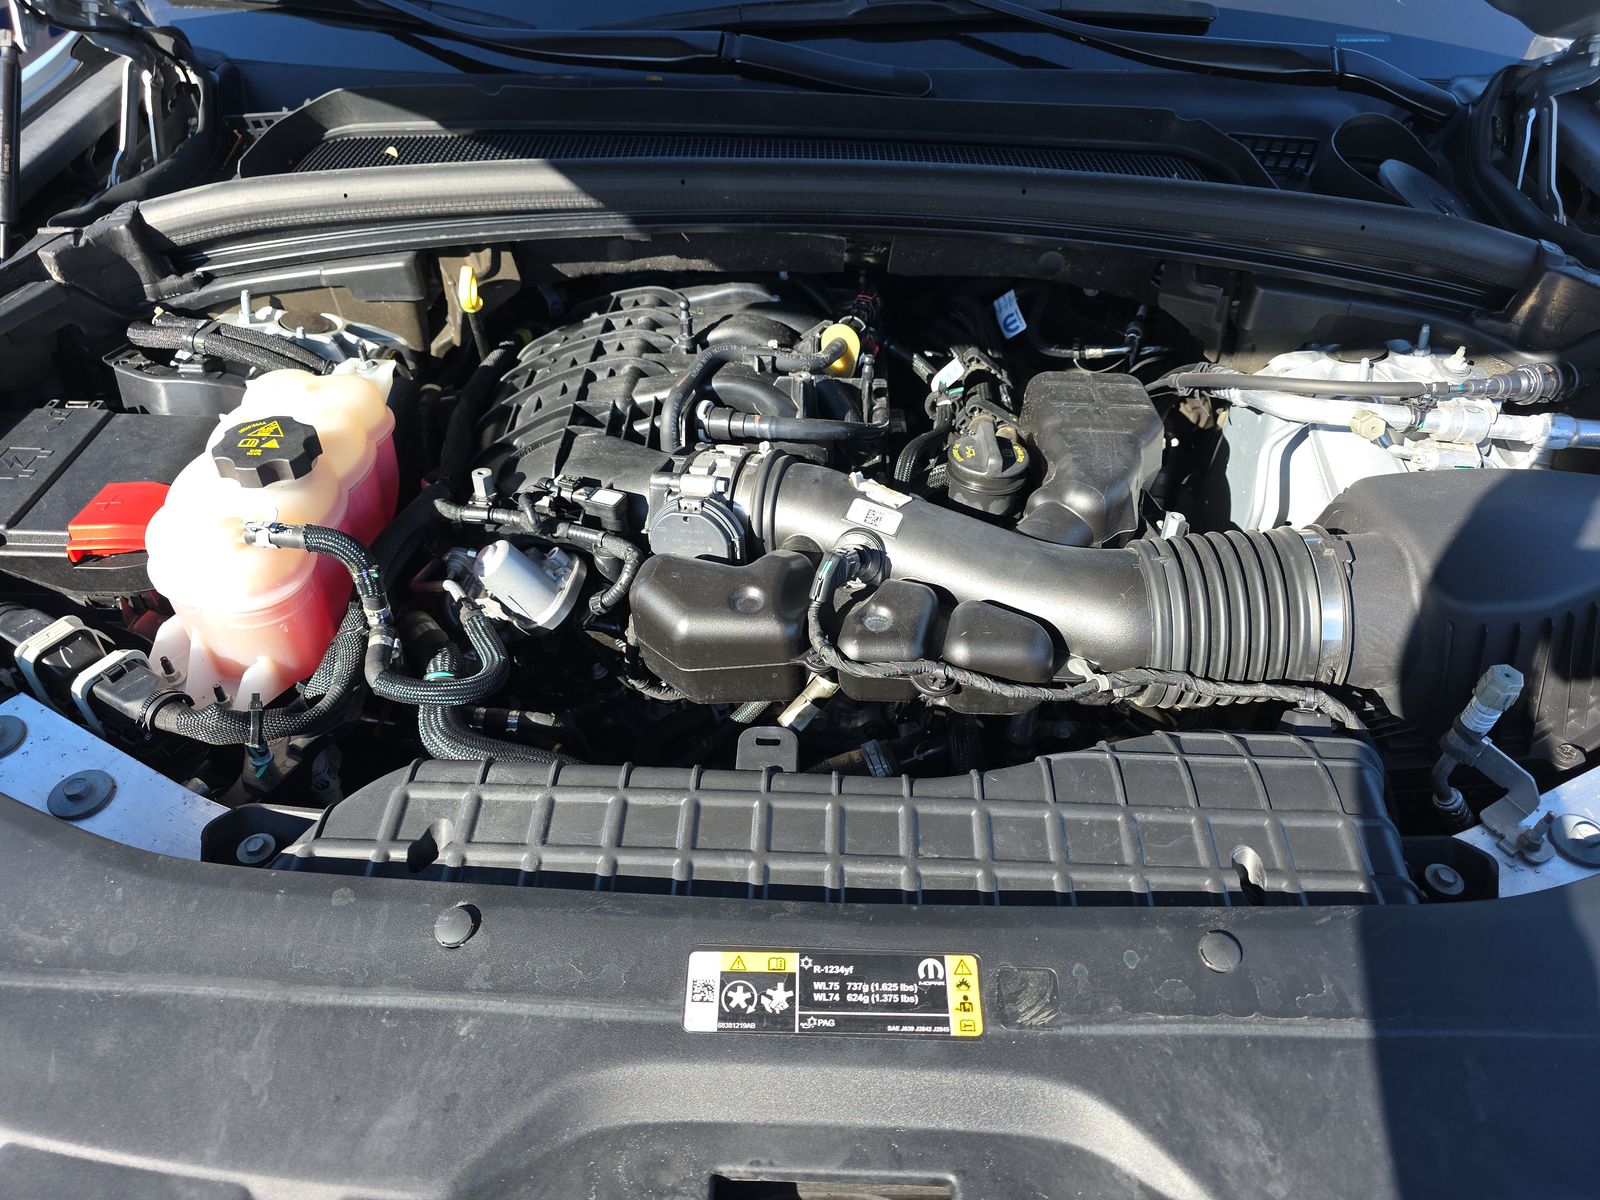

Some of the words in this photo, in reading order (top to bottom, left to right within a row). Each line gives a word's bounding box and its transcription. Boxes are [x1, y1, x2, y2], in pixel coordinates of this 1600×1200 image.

[813, 965, 854, 975] R-1234yf
[813, 981, 840, 990] WL75
[846, 982, 869, 992] 737g
[870, 982, 899, 993] (1.625
[900, 983, 919, 993] lbs)
[813, 993, 840, 1002] WL74
[846, 993, 869, 1004] 624g
[870, 994, 899, 1004] (1.375
[900, 994, 919, 1005] lbs)
[817, 1019, 836, 1027] PAG
